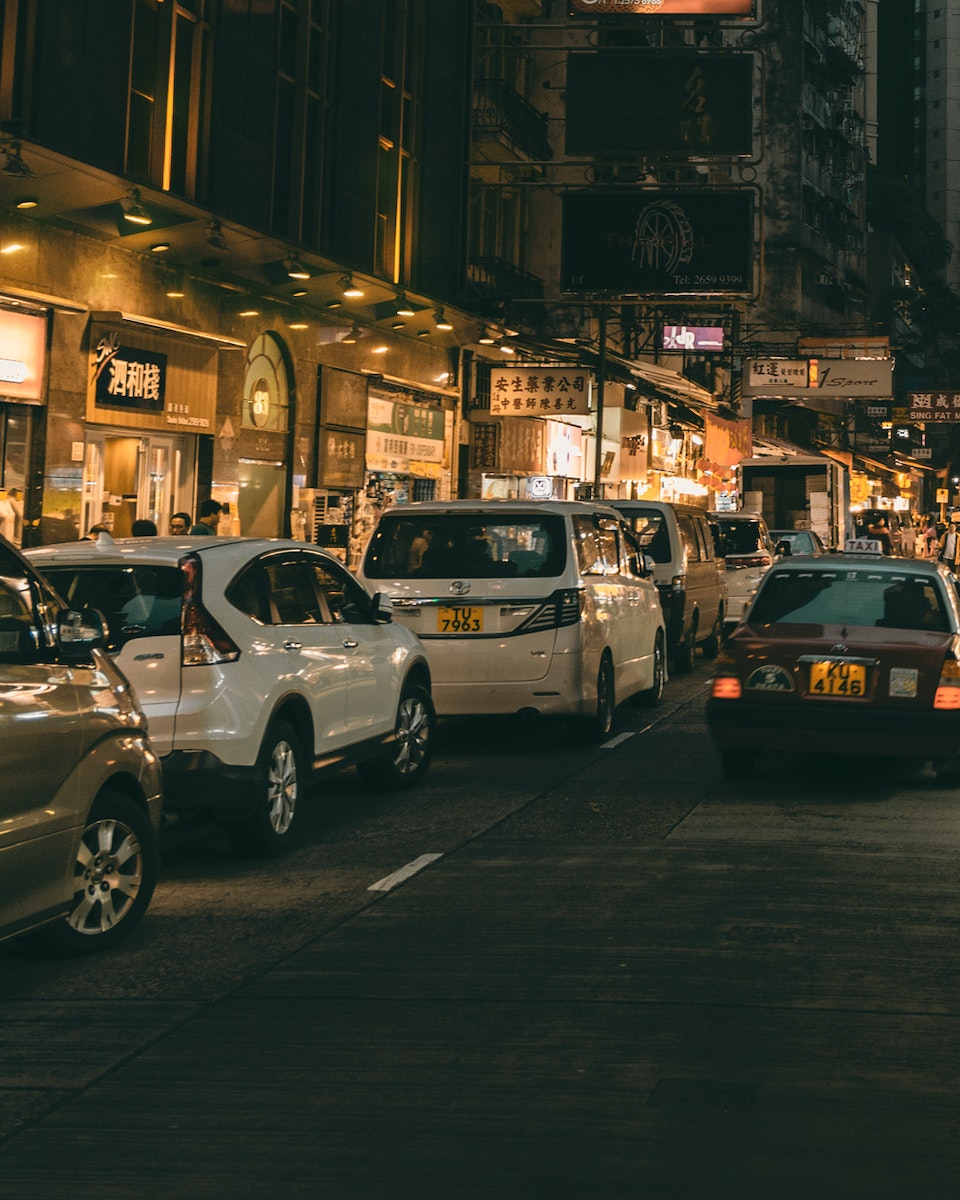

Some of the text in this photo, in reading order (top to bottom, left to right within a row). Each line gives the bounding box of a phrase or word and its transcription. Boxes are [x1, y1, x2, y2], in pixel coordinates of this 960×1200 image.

[694, 275, 717, 284] 2659
[719, 275, 743, 284] 9399
[910, 411, 932, 420] SING
[934, 411, 951, 420] FAT
[849, 541, 879, 551] TAXI
[452, 607, 471, 620] TU
[442, 619, 480, 632] 7963
[827, 662, 850, 679] KU
[813, 679, 862, 695] 4146
